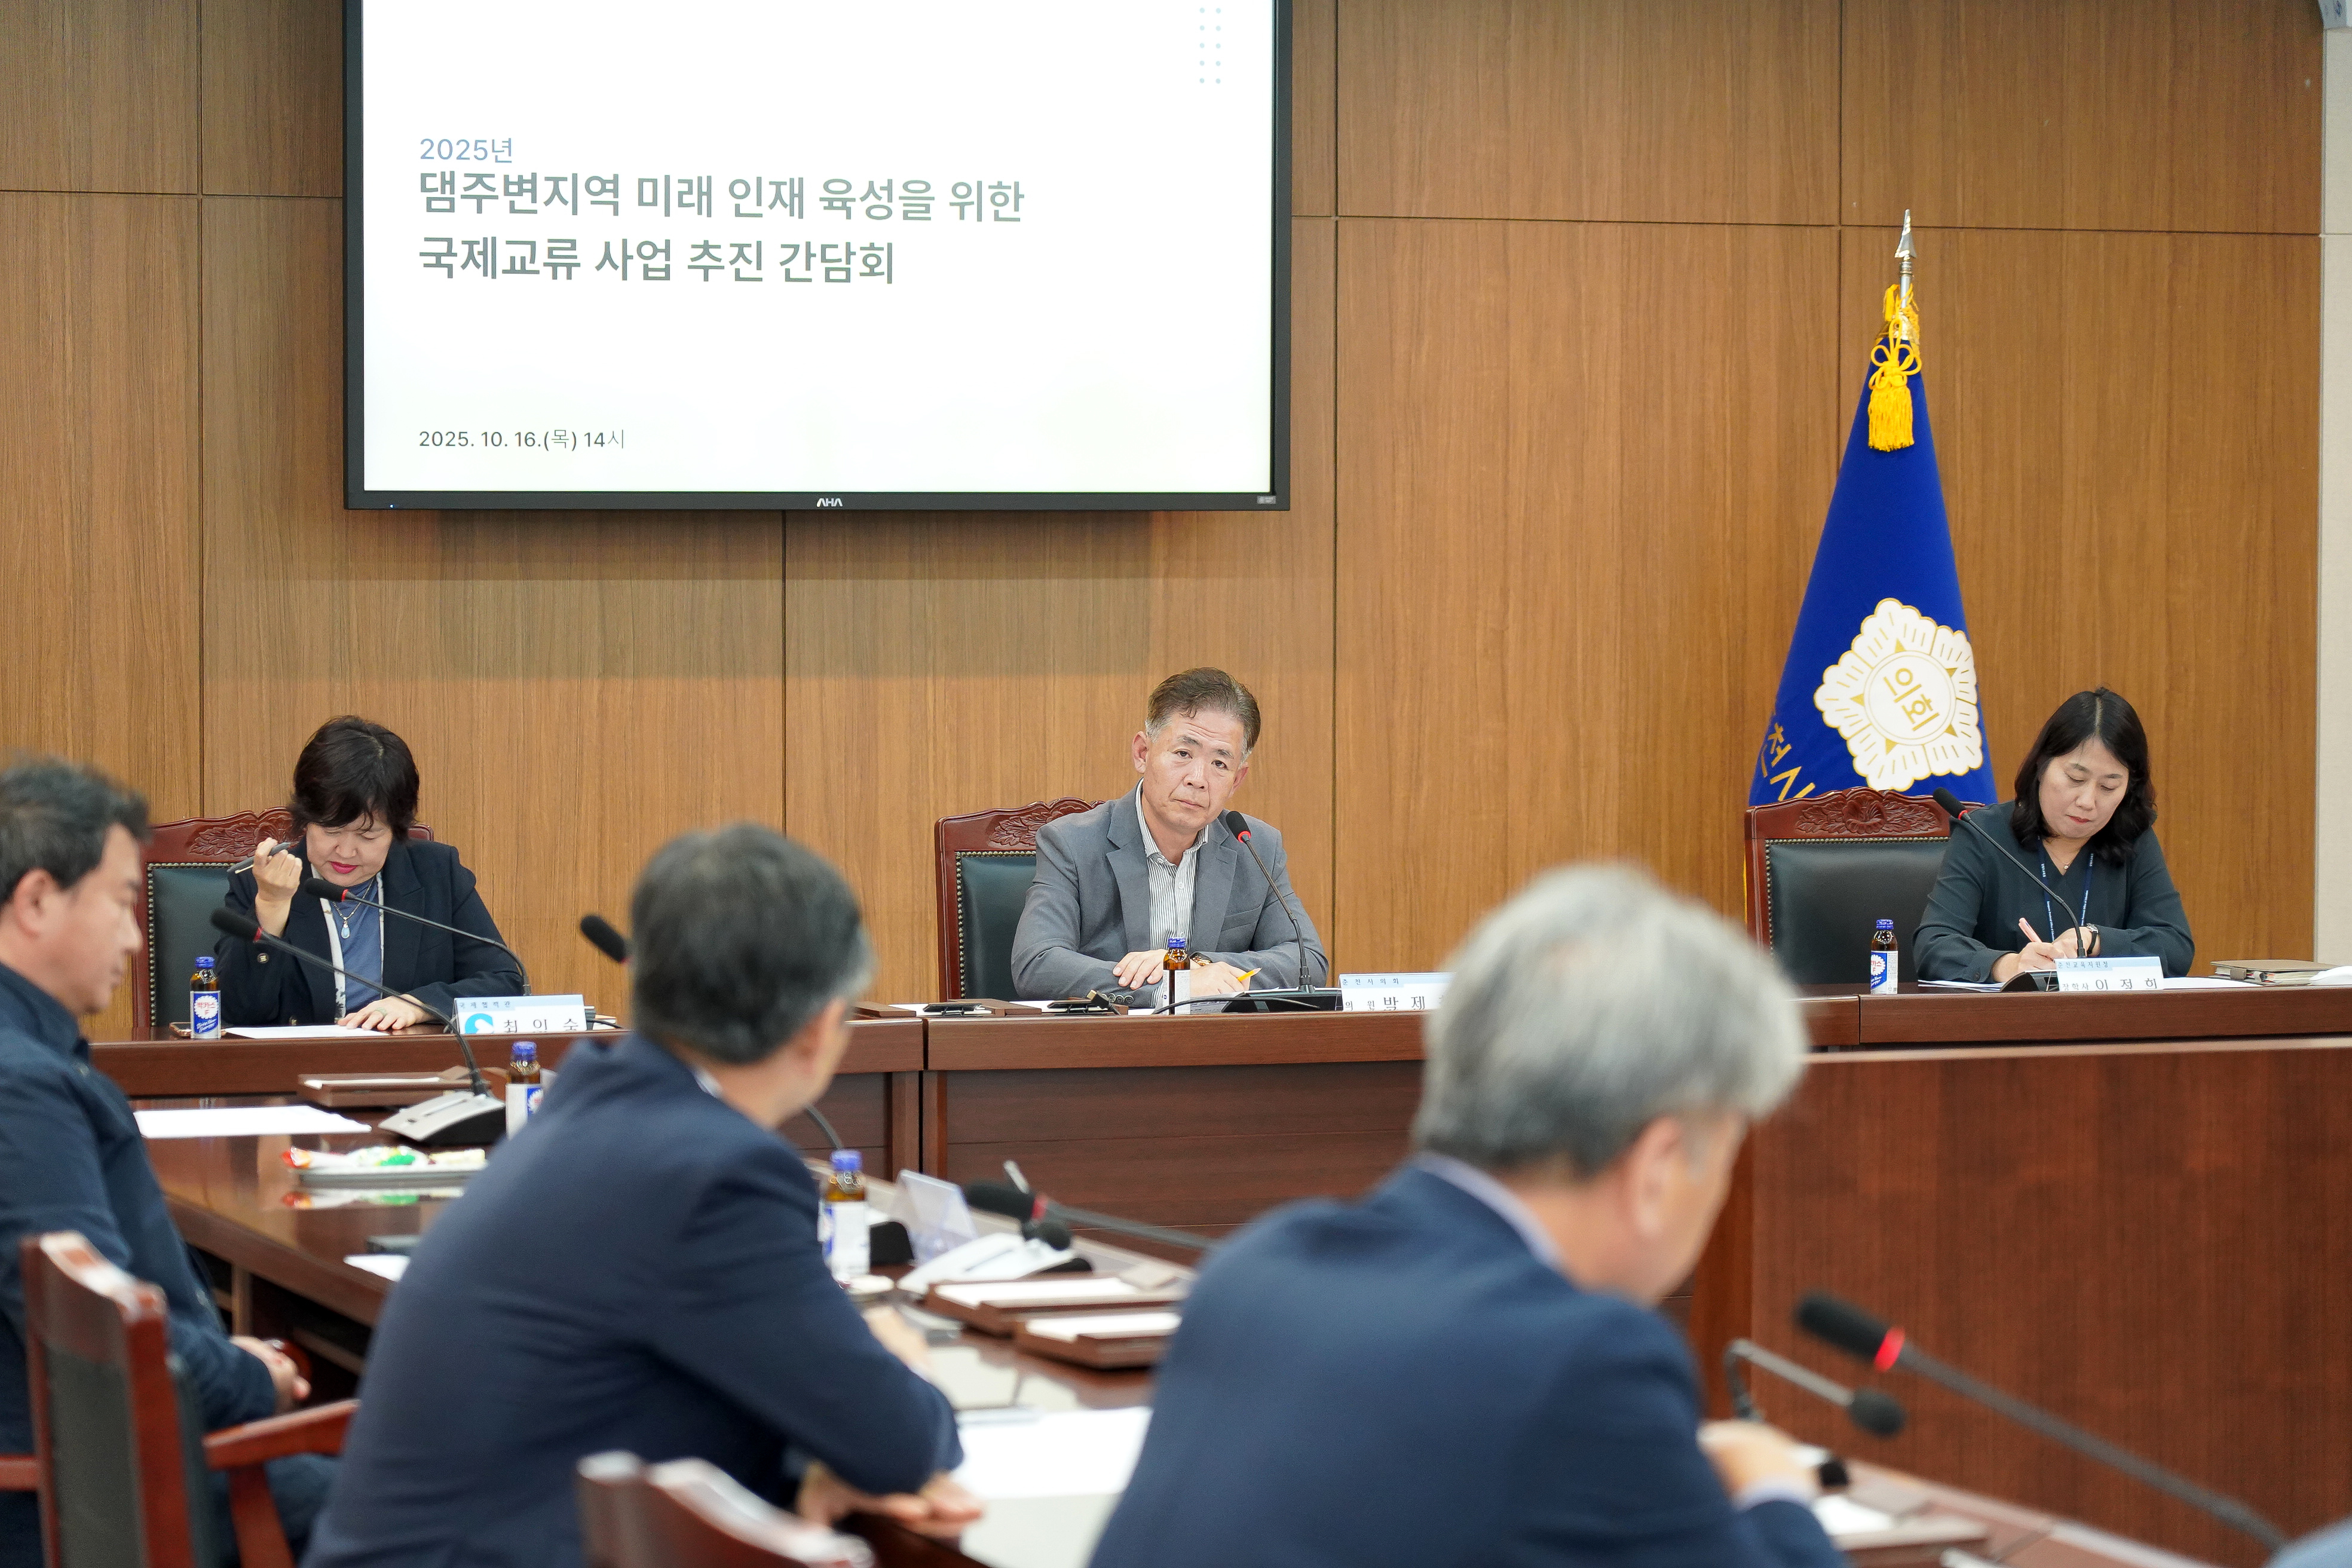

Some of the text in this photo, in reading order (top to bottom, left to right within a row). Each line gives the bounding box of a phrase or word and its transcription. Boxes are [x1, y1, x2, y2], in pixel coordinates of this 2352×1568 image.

[420, 137, 512, 163] 2025년
[420, 170, 1025, 222] 댐주변지역 미래 인재 육성을 위한
[419, 236, 893, 284] 국제교류 사업 추진 간담회
[419, 431, 474, 447] 2025.
[481, 431, 508, 447] 10.
[584, 429, 624, 449] 14시
[816, 498, 843, 507] AHA
[1883, 667, 1940, 732] 의회
[1383, 996, 1444, 1012] 박제
